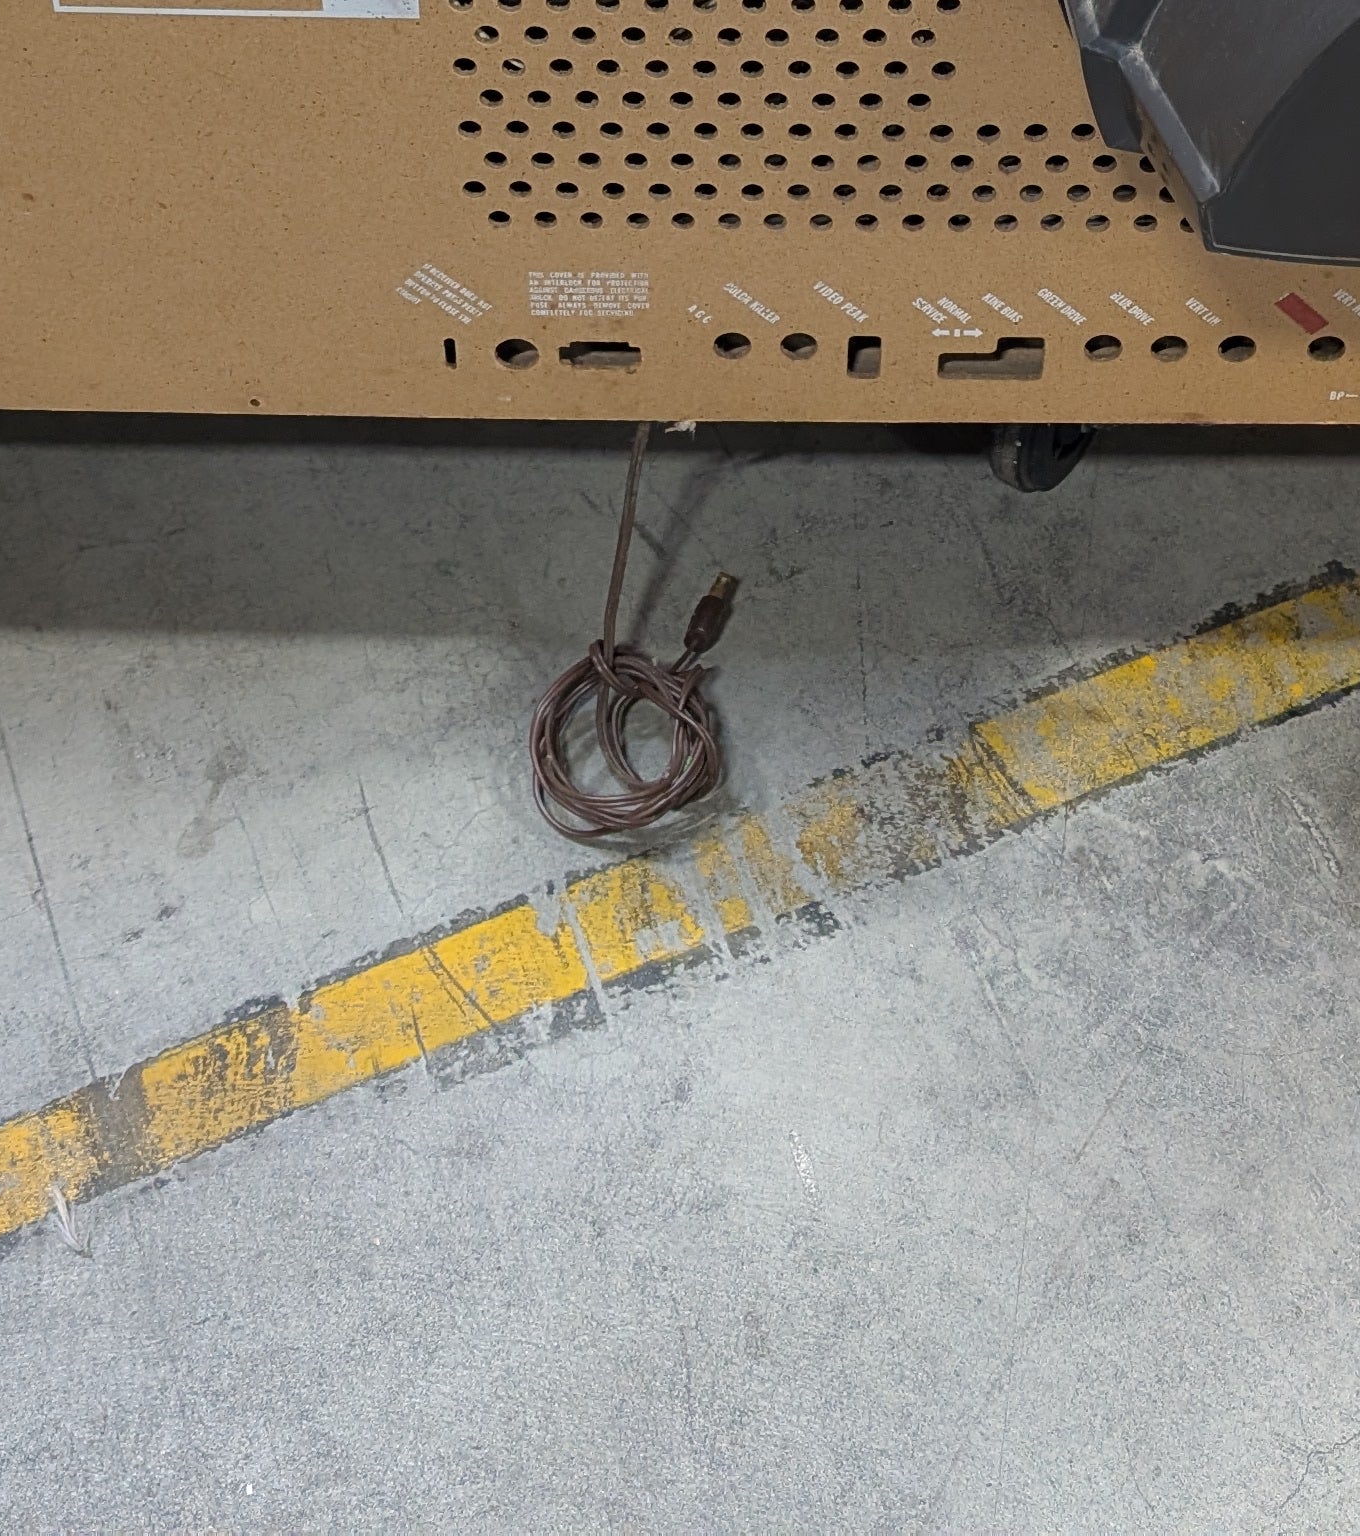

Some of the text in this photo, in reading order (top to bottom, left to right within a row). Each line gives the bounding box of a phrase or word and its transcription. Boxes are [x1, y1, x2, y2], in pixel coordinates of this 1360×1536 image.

[549, 271, 573, 279] COVER
[750, 300, 781, 325] KILLER
[813, 280, 870, 324] VIDEO PEAK
[911, 297, 948, 325] SERVICE
[937, 296, 972, 325] NORMAL
[981, 292, 1024, 323] KINE BIAS
[1036, 287, 1088, 326] GREEN DRIVE
[1109, 291, 1156, 326] BLUE DRIVE
[1184, 296, 1223, 327] VERT LIN
[1333, 288, 1357, 308] VERT
